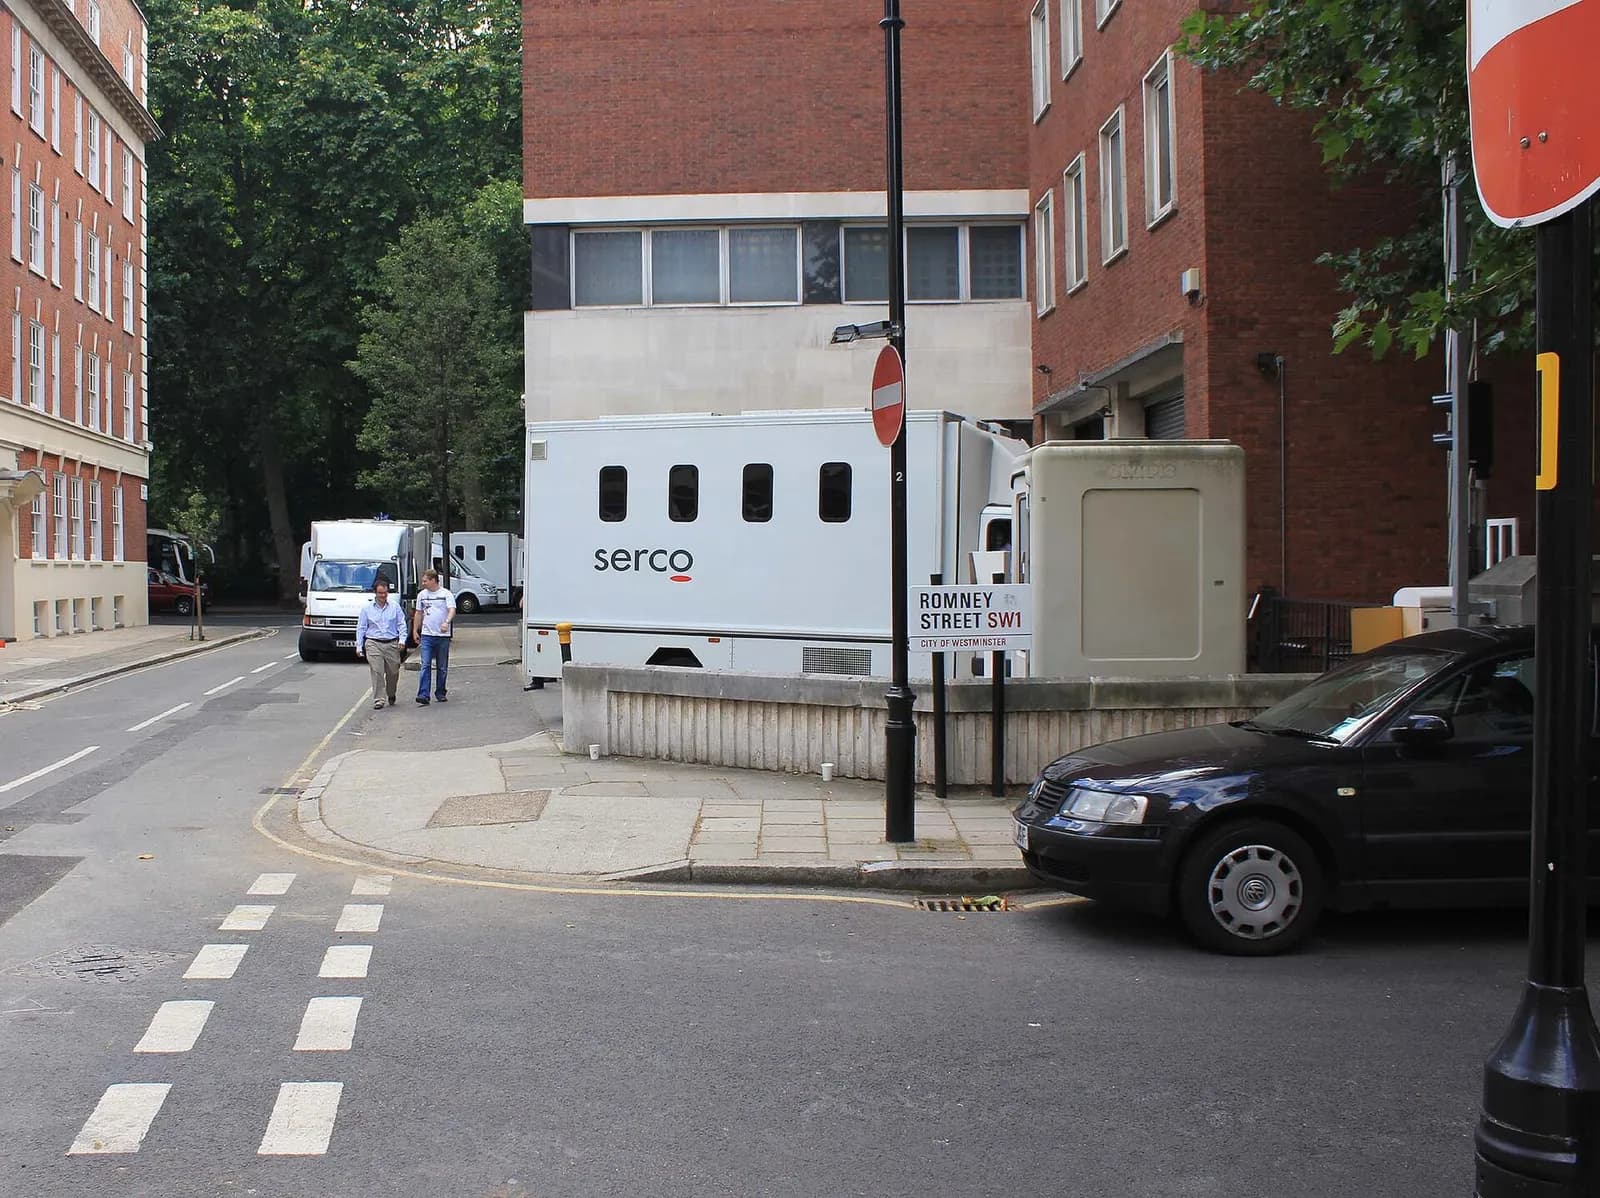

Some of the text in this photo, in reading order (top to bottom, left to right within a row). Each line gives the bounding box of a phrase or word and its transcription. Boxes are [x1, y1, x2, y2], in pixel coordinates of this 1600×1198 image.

[895, 471, 903, 482] 2
[594, 548, 693, 572] serco
[920, 592, 993, 609] ROMNEY
[920, 611, 1022, 630] STREET SW1
[920, 638, 1007, 648] CITY OF WESTMINSTER
